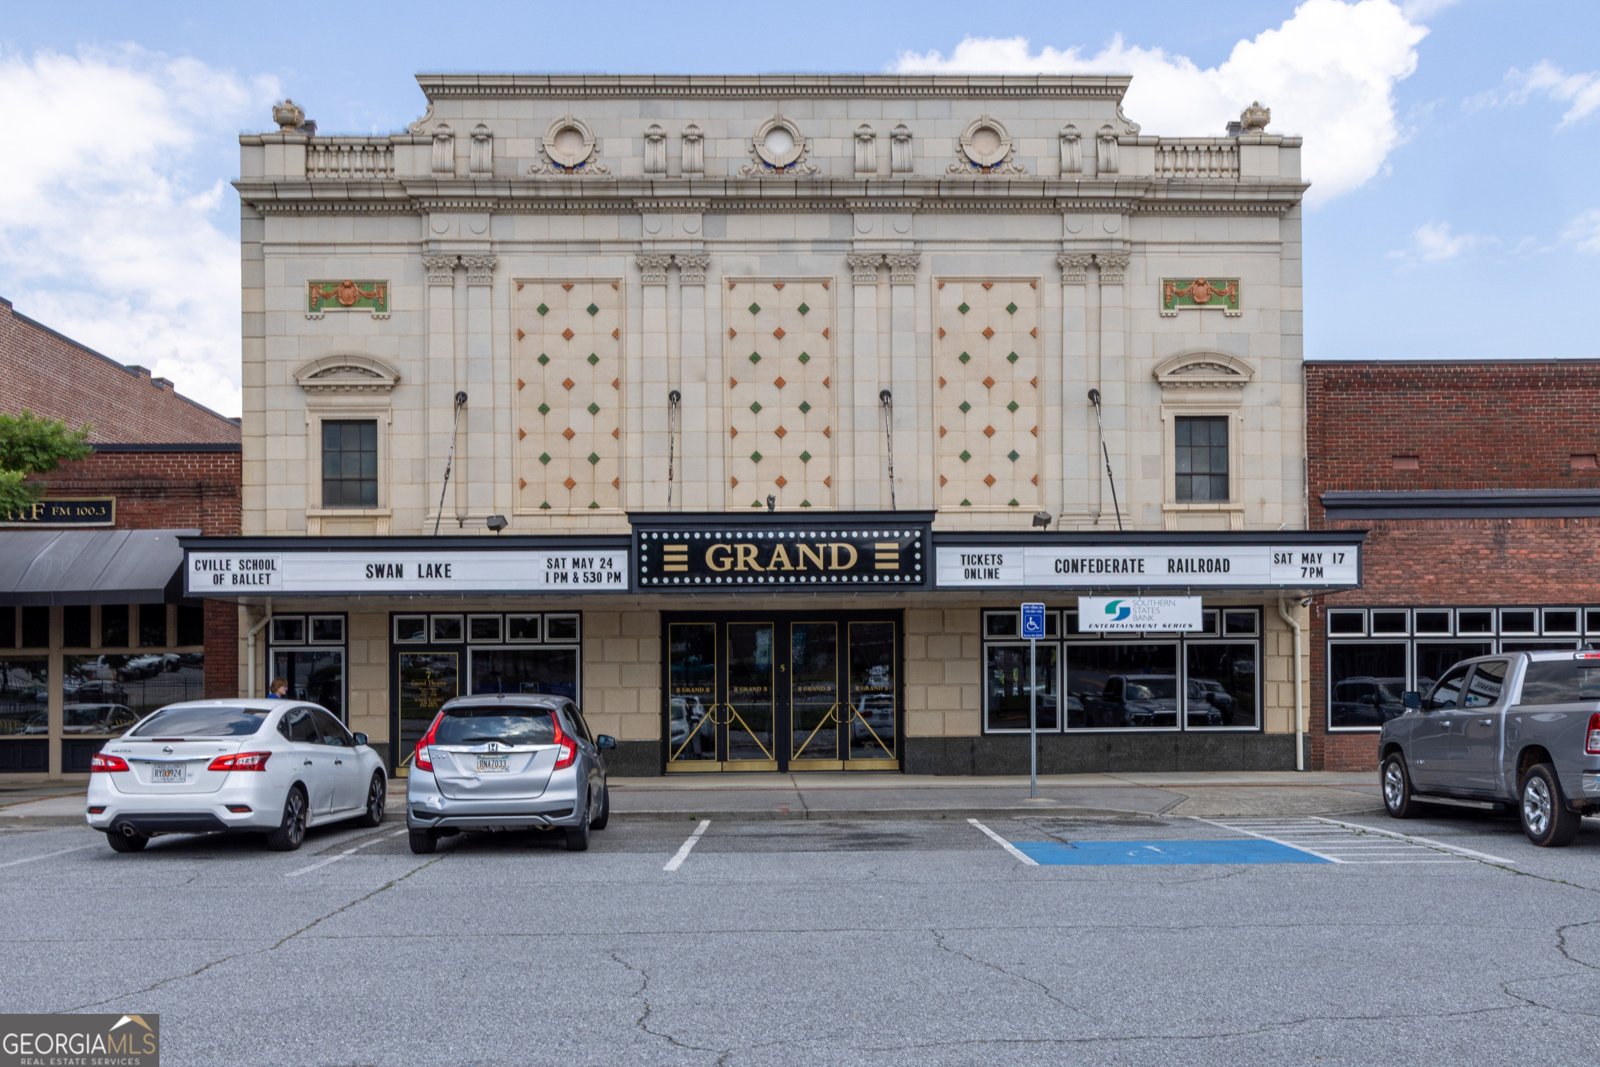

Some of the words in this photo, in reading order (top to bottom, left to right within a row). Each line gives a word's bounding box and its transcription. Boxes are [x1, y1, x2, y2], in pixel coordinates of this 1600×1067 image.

[52, 507, 71, 516] FM
[76, 506, 106, 516] 100.3
[705, 542, 858, 572] GRAND
[960, 554, 1003, 566] TICKETS
[1274, 552, 1293, 564] SAT
[1301, 552, 1323, 564] MAY
[1332, 552, 1345, 564] 17
[195, 559, 232, 571] CVILLE
[239, 559, 277, 571] SCHOOL
[546, 557, 567, 570] SAT
[572, 557, 594, 570] MAY
[600, 557, 613, 570] 24
[1054, 558, 1145, 574] CONFEDERATE
[1167, 558, 1231, 573] RAILROAD
[365, 563, 404, 579] SWAN
[418, 563, 452, 579] LAKE
[554, 571, 568, 583] PM
[572, 571, 579, 583] &
[583, 571, 602, 583] 530
[607, 571, 622, 583] PM
[964, 568, 1000, 580] ONLINE
[213, 573, 225, 585] OF
[232, 573, 271, 585] BALLET
[425, 671, 432, 679] 7
[681, 686, 706, 694] GRAND
